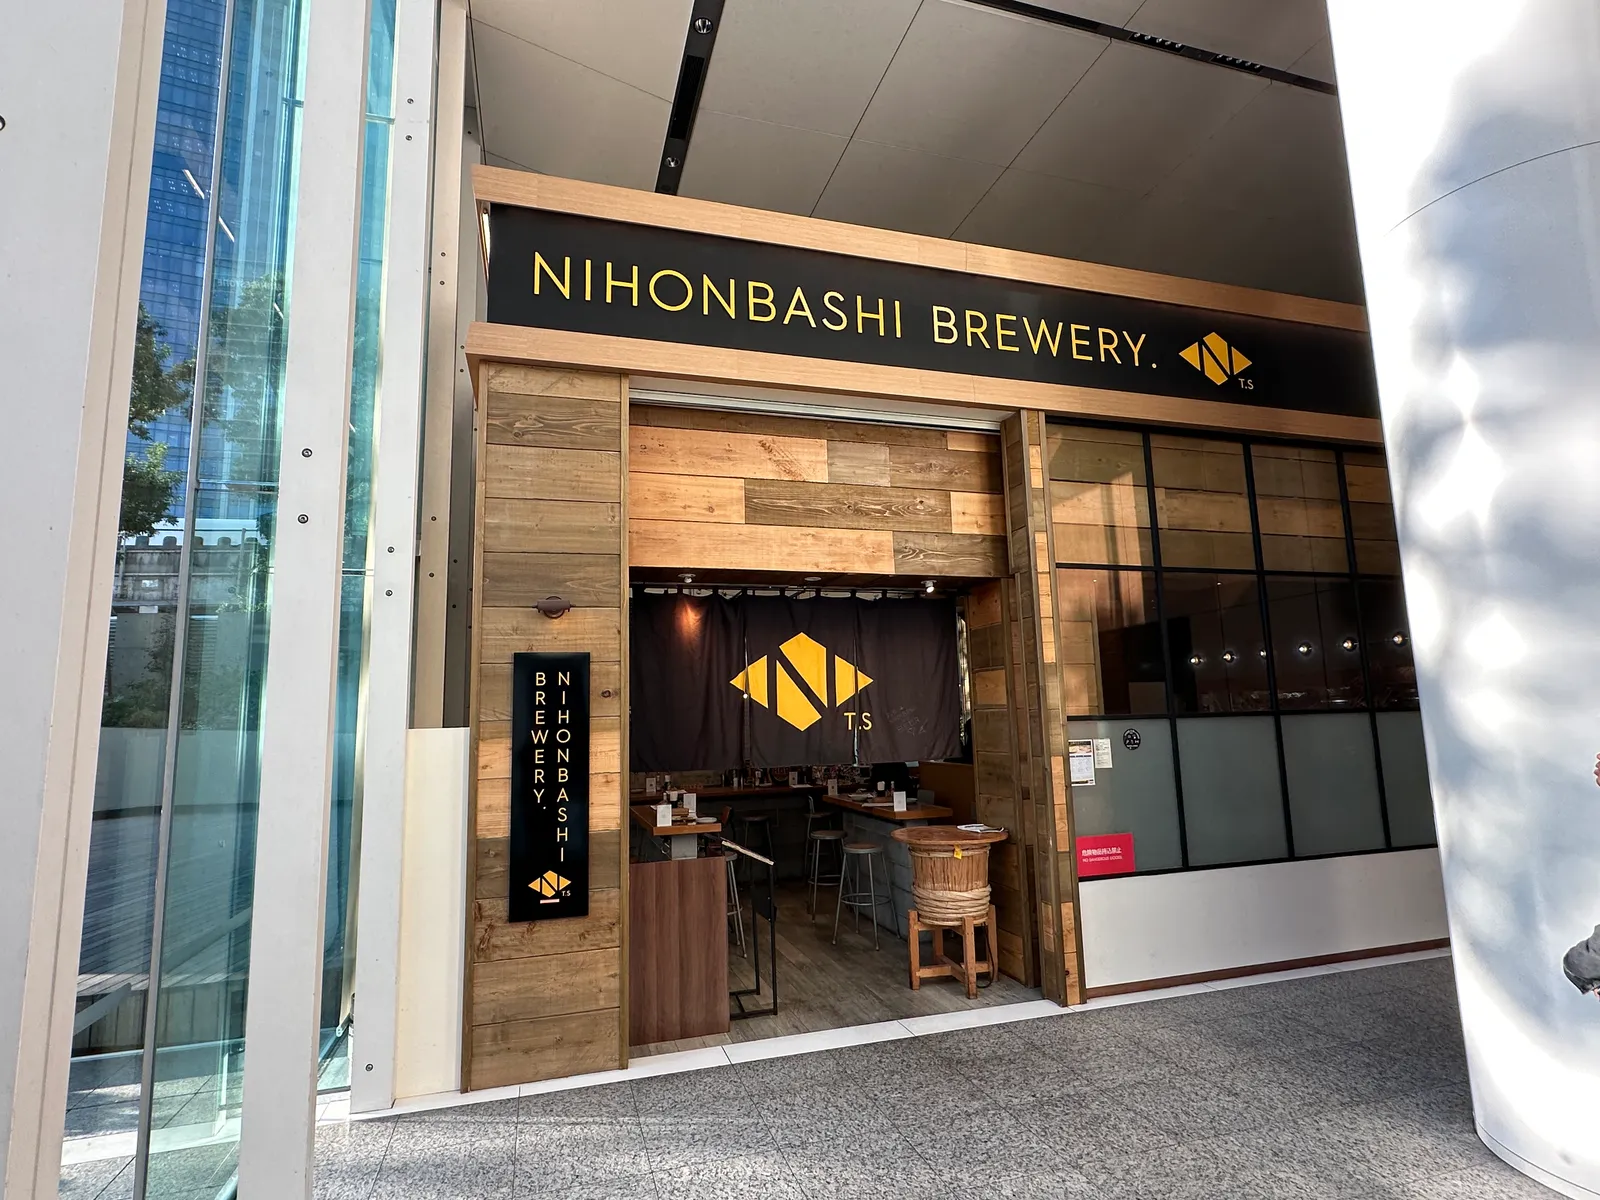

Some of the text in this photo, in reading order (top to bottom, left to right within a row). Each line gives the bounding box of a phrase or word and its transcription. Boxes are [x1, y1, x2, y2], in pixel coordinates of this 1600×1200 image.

[532, 251, 1158, 370] NIHONBASHI BREWERY.
[1238, 378, 1254, 390] T.S
[531, 671, 549, 810] BREWERY.
[556, 671, 571, 862] NIHONBASHI
